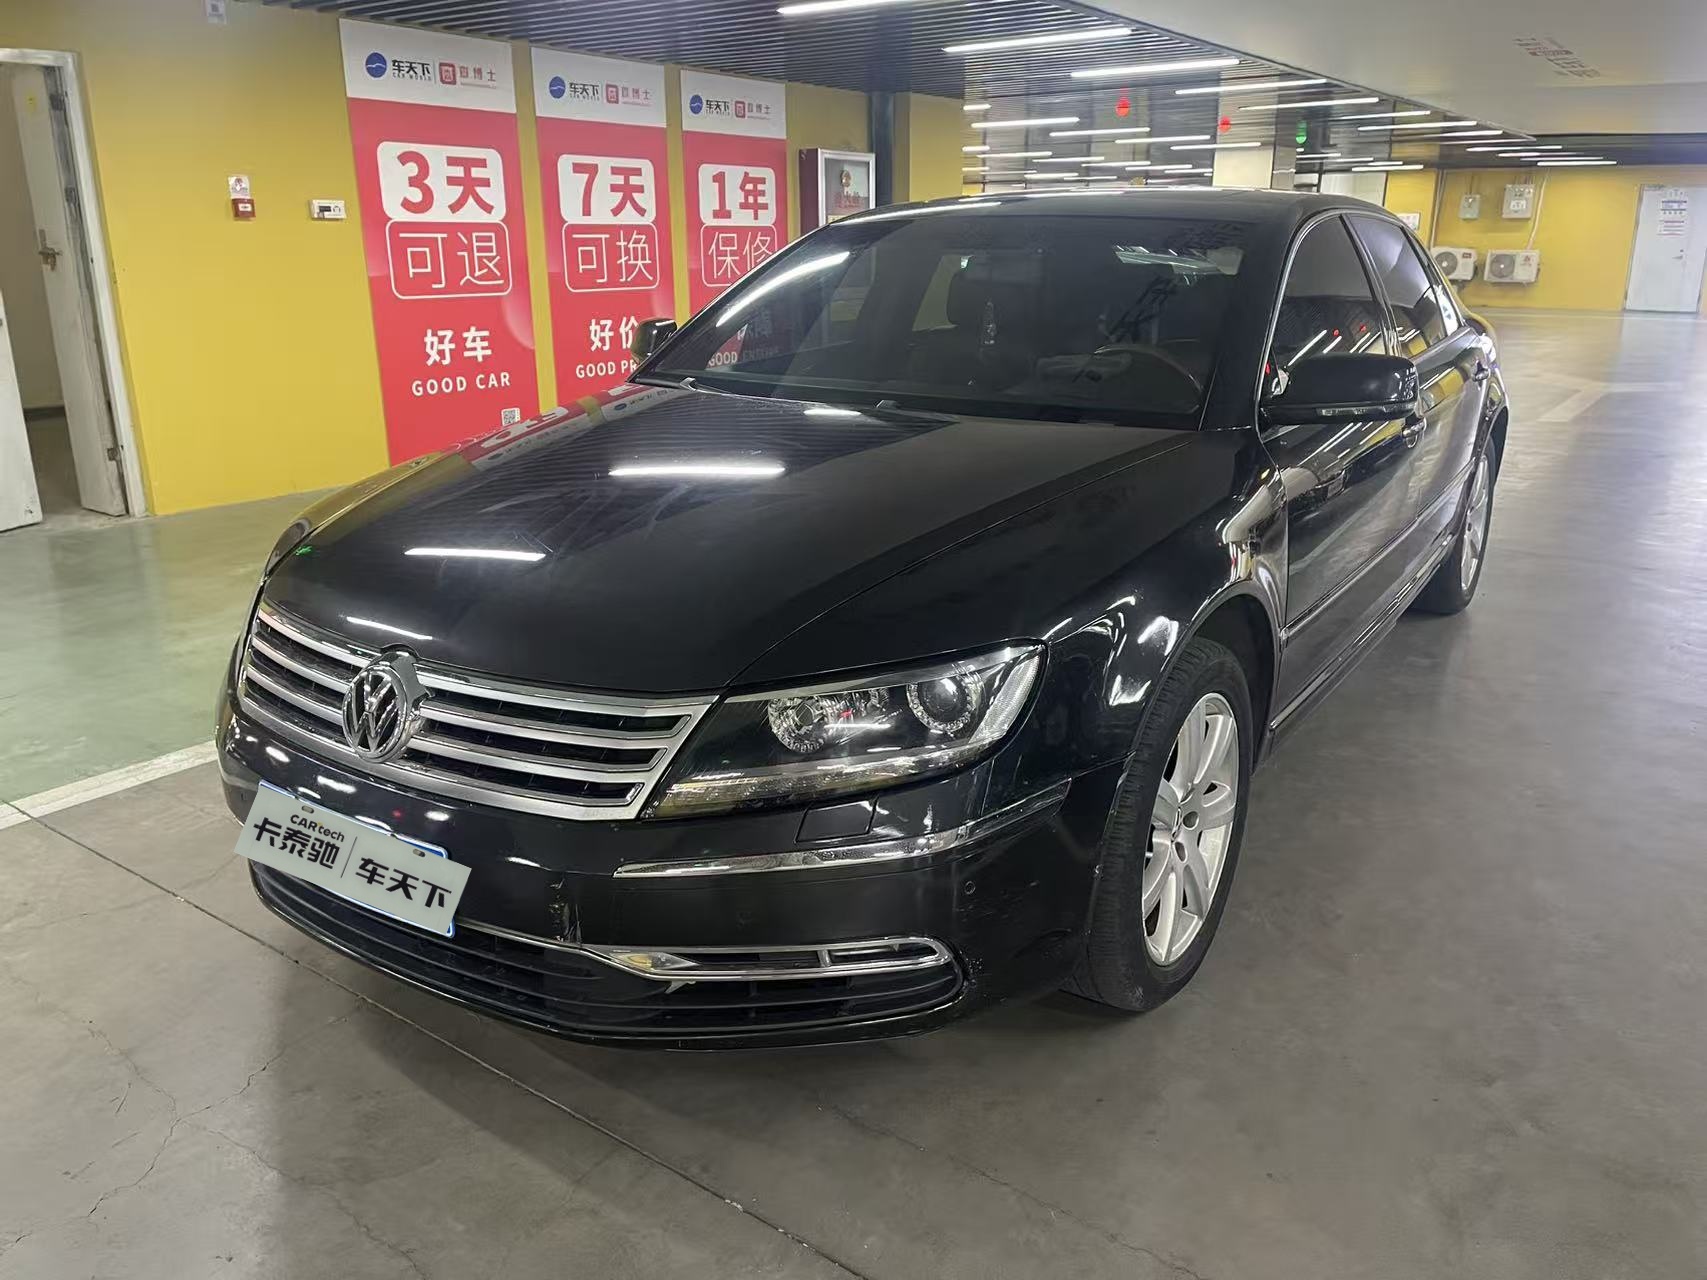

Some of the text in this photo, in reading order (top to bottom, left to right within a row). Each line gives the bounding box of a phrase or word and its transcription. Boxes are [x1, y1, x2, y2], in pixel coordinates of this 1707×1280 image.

[391, 59, 431, 77] 车天下
[569, 82, 600, 97] 车天下
[705, 99, 730, 112] 车天下
[396, 150, 496, 215] 3天
[571, 162, 647, 218] 7天
[711, 171, 769, 221] 1年
[398, 231, 505, 290] 可退
[573, 230, 653, 290] 可换
[708, 231, 773, 279] 保修
[423, 325, 493, 367] 好车
[589, 315, 639, 351] 好价
[411, 371, 511, 397] GOOD CAR
[575, 361, 616, 379] GOOD
[253, 817, 452, 909] 卡泰驰 车天下
